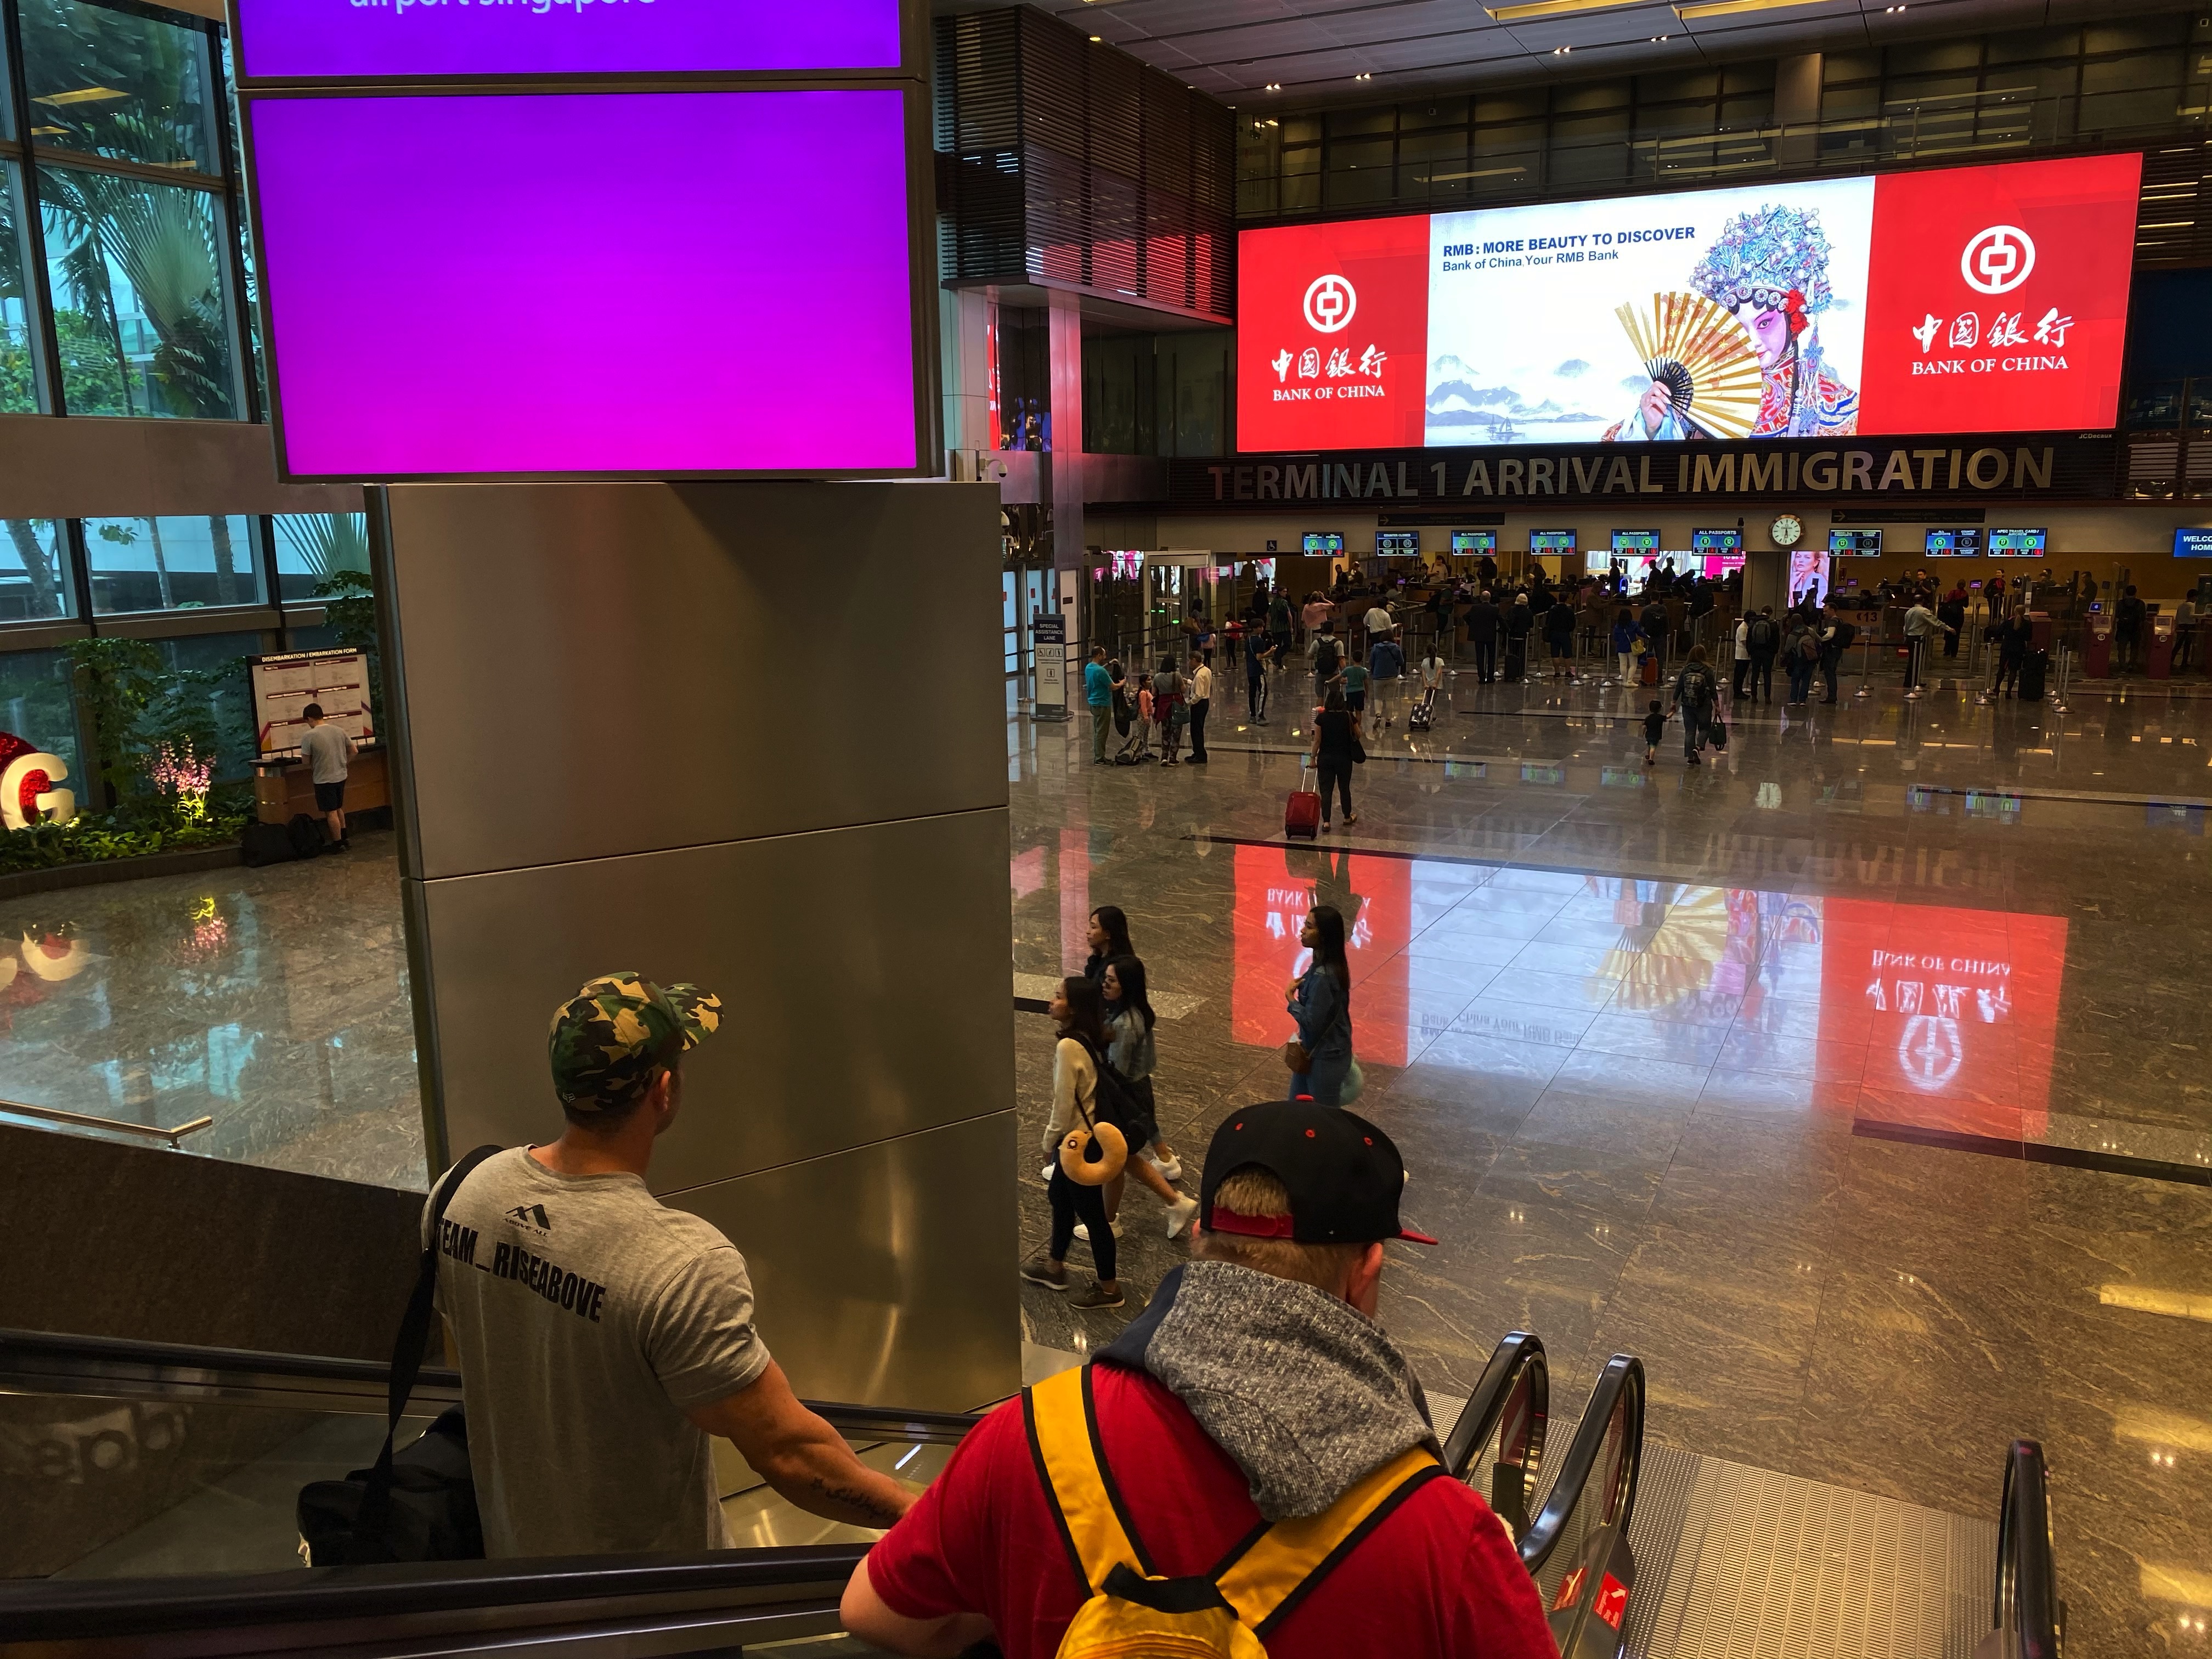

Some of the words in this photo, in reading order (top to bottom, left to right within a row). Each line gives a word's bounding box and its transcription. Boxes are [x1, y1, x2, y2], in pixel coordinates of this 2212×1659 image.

[1483, 239, 1524, 254] MORE
[1528, 234, 1589, 251] BEAUTY
[1592, 233, 1612, 246] TO
[1617, 227, 1695, 244] DISCOVER
[1443, 259, 1471, 272] Bank
[1474, 258, 1486, 269] of
[1556, 252, 1584, 263] RMB
[1589, 250, 1618, 261] Bank
[1912, 307, 2075, 354] 中國銀行
[1271, 343, 1387, 383] 中國銀行
[1912, 359, 1965, 375] BANK
[1971, 358, 1996, 373] OF
[2002, 356, 2069, 371] CHINA
[1273, 388, 1311, 401] BANK
[1315, 387, 1334, 399] OF
[1337, 385, 1385, 398] CHINA
[1207, 461, 1419, 500] TERMINAL
[1430, 461, 1446, 496] 1
[1462, 455, 1663, 496] ARRIVAL
[1678, 447, 2055, 493] IMMIGRATION
[1864, 612, 1877, 622] 13
[262, 652, 306, 662] DISEMBARKATION
[309, 649, 343, 657] EMBARKATION
[502, 1218, 532, 1231] ABOVE
